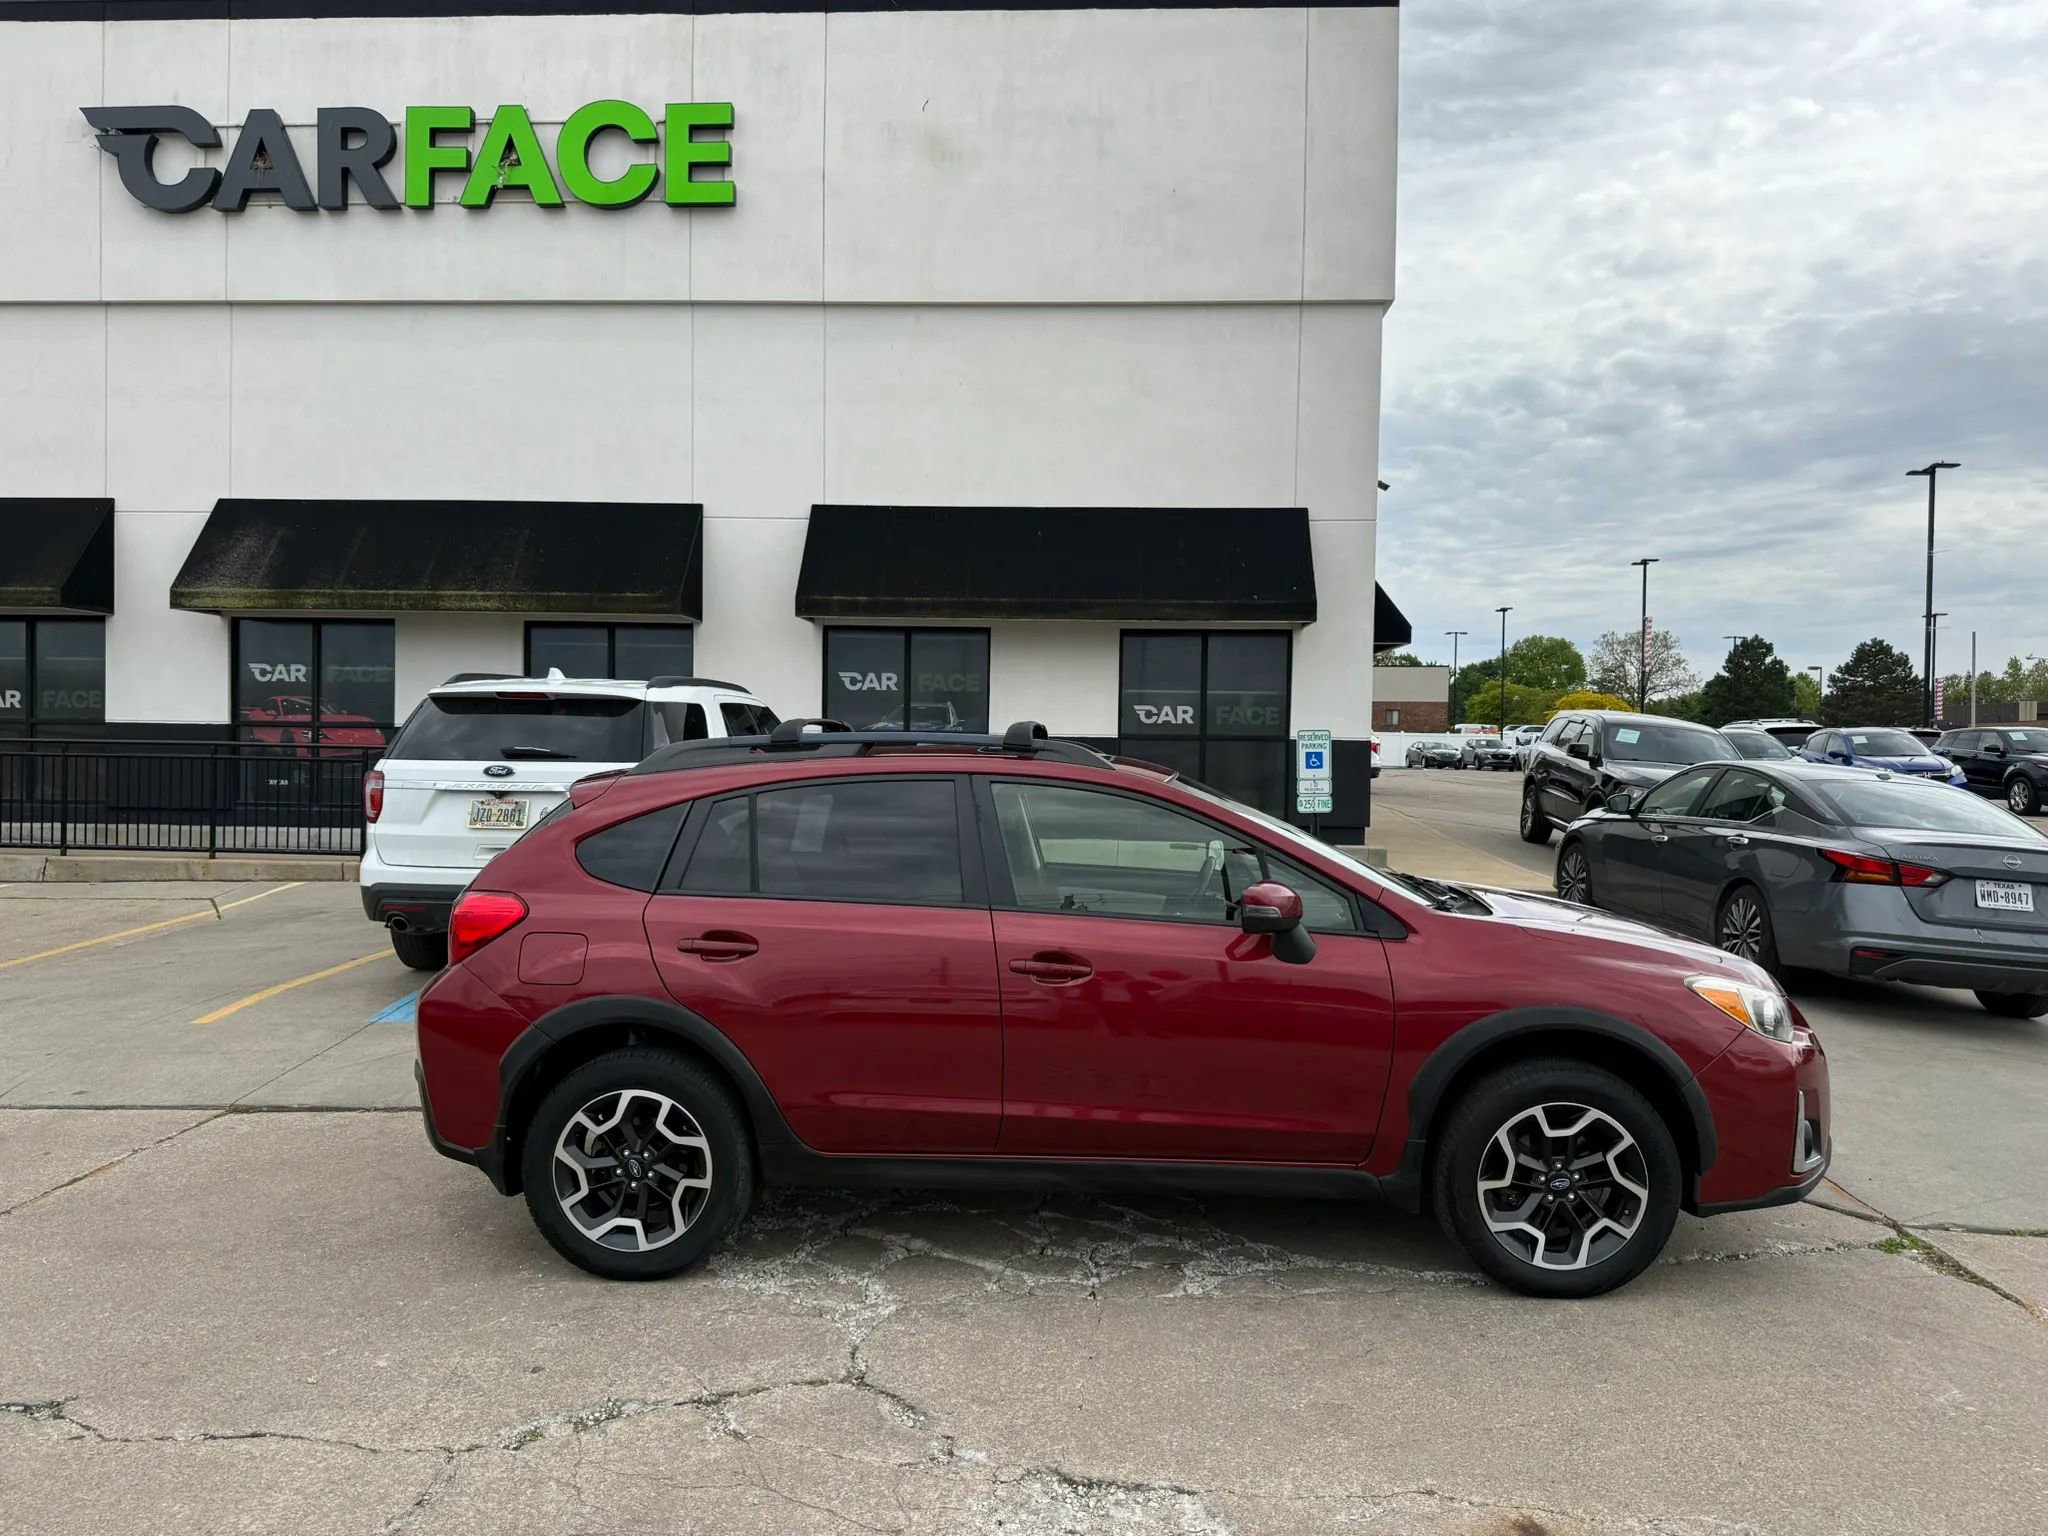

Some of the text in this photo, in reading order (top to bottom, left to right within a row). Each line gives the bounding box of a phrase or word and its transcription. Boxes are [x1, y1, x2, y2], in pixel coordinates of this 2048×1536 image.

[248, 663, 307, 682] CAR
[838, 672, 981, 692] CAR FACE
[1133, 705, 1280, 725] CAR FACE
[1299, 734, 1329, 742] RESERVED
[1317, 799, 1331, 809] FINE
[1993, 882, 2016, 890] TEXAS
